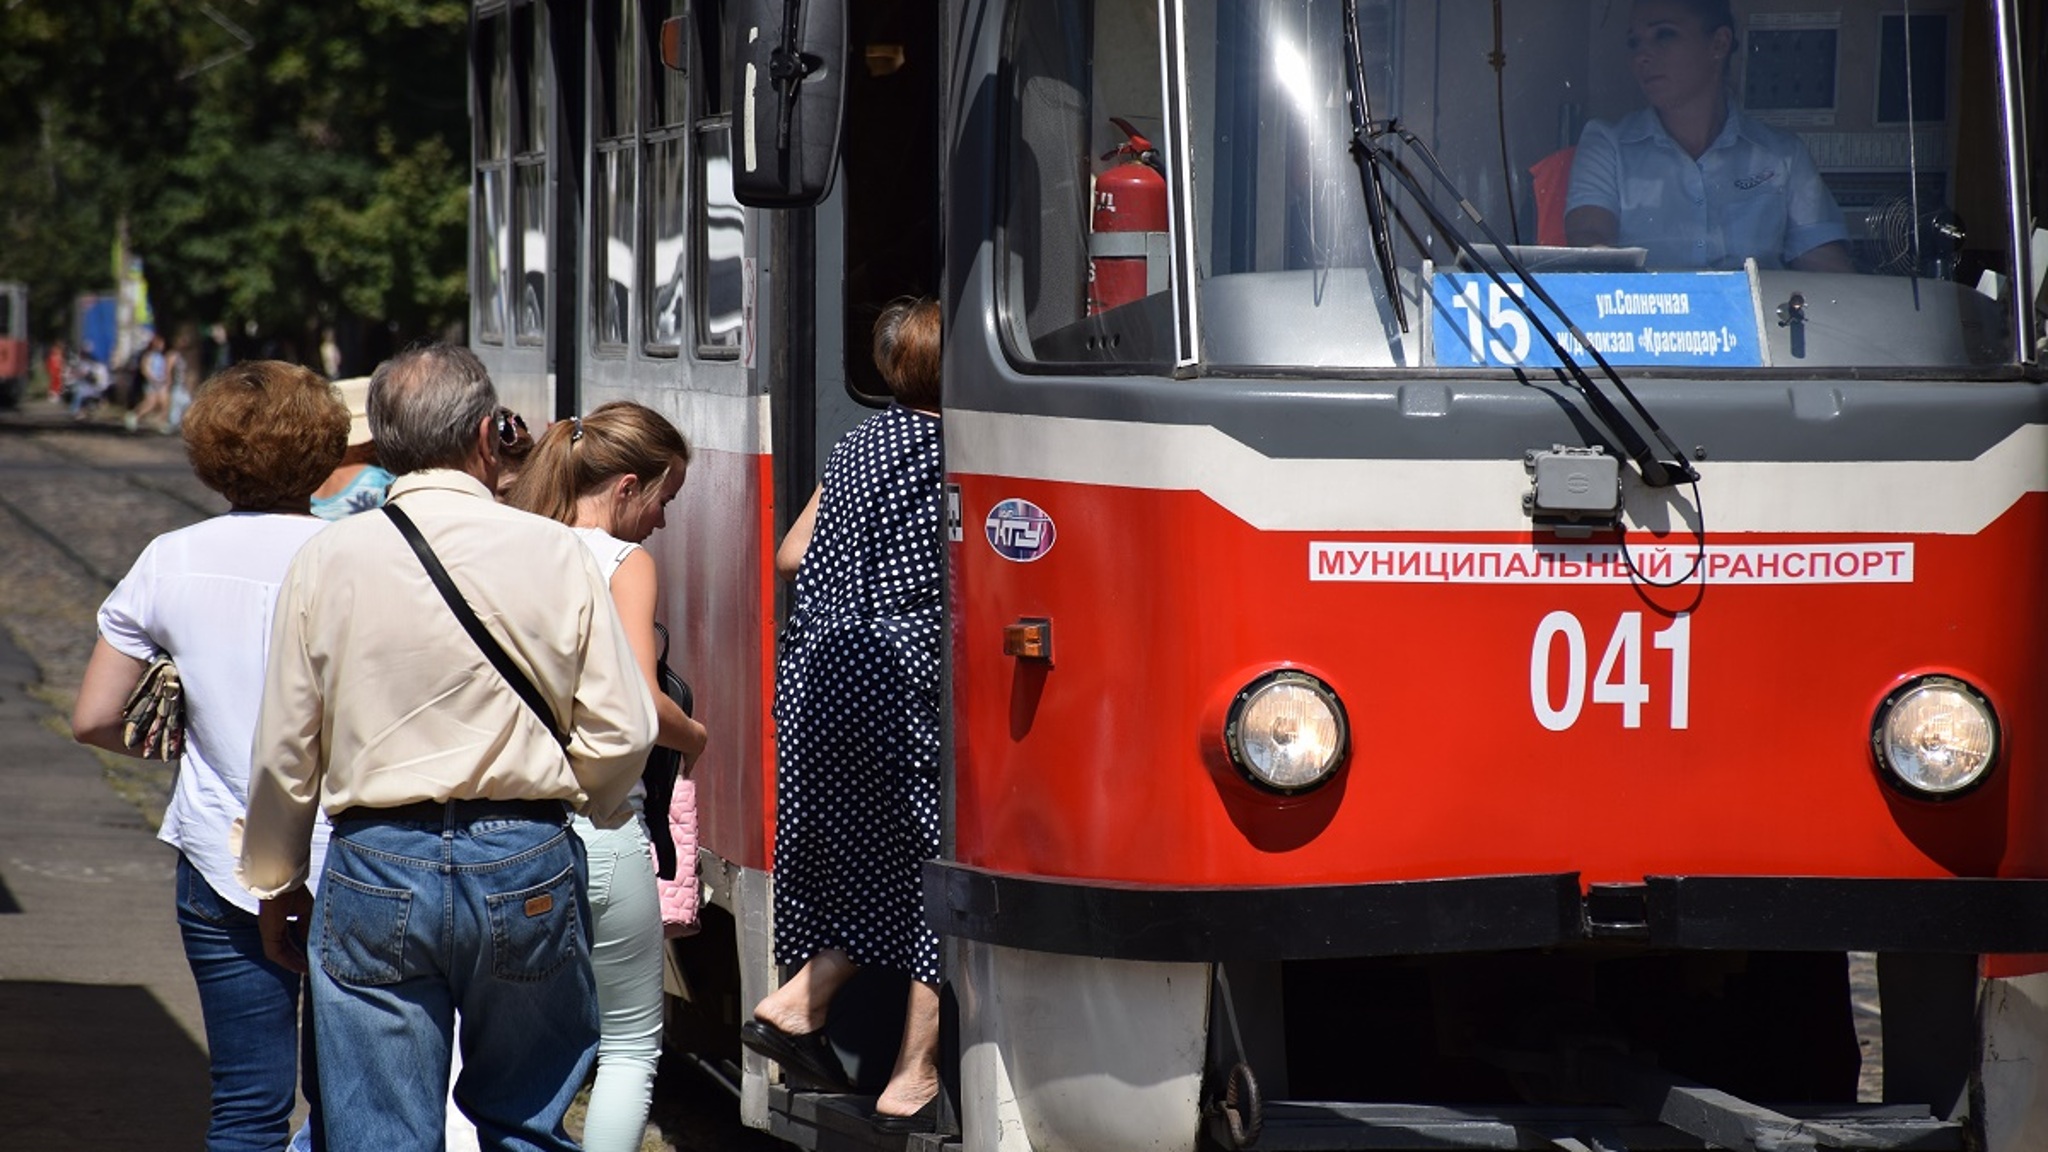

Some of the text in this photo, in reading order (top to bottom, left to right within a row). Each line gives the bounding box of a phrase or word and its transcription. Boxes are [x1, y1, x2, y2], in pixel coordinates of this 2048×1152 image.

[1453, 281, 1531, 365] 15
[1596, 288, 1690, 318] ул.Солнечная
[1317, 547, 1906, 581] МУНИЦИПАЛЬНЫЙ ТРАНСПОРТ
[1530, 610, 1692, 732] 041
